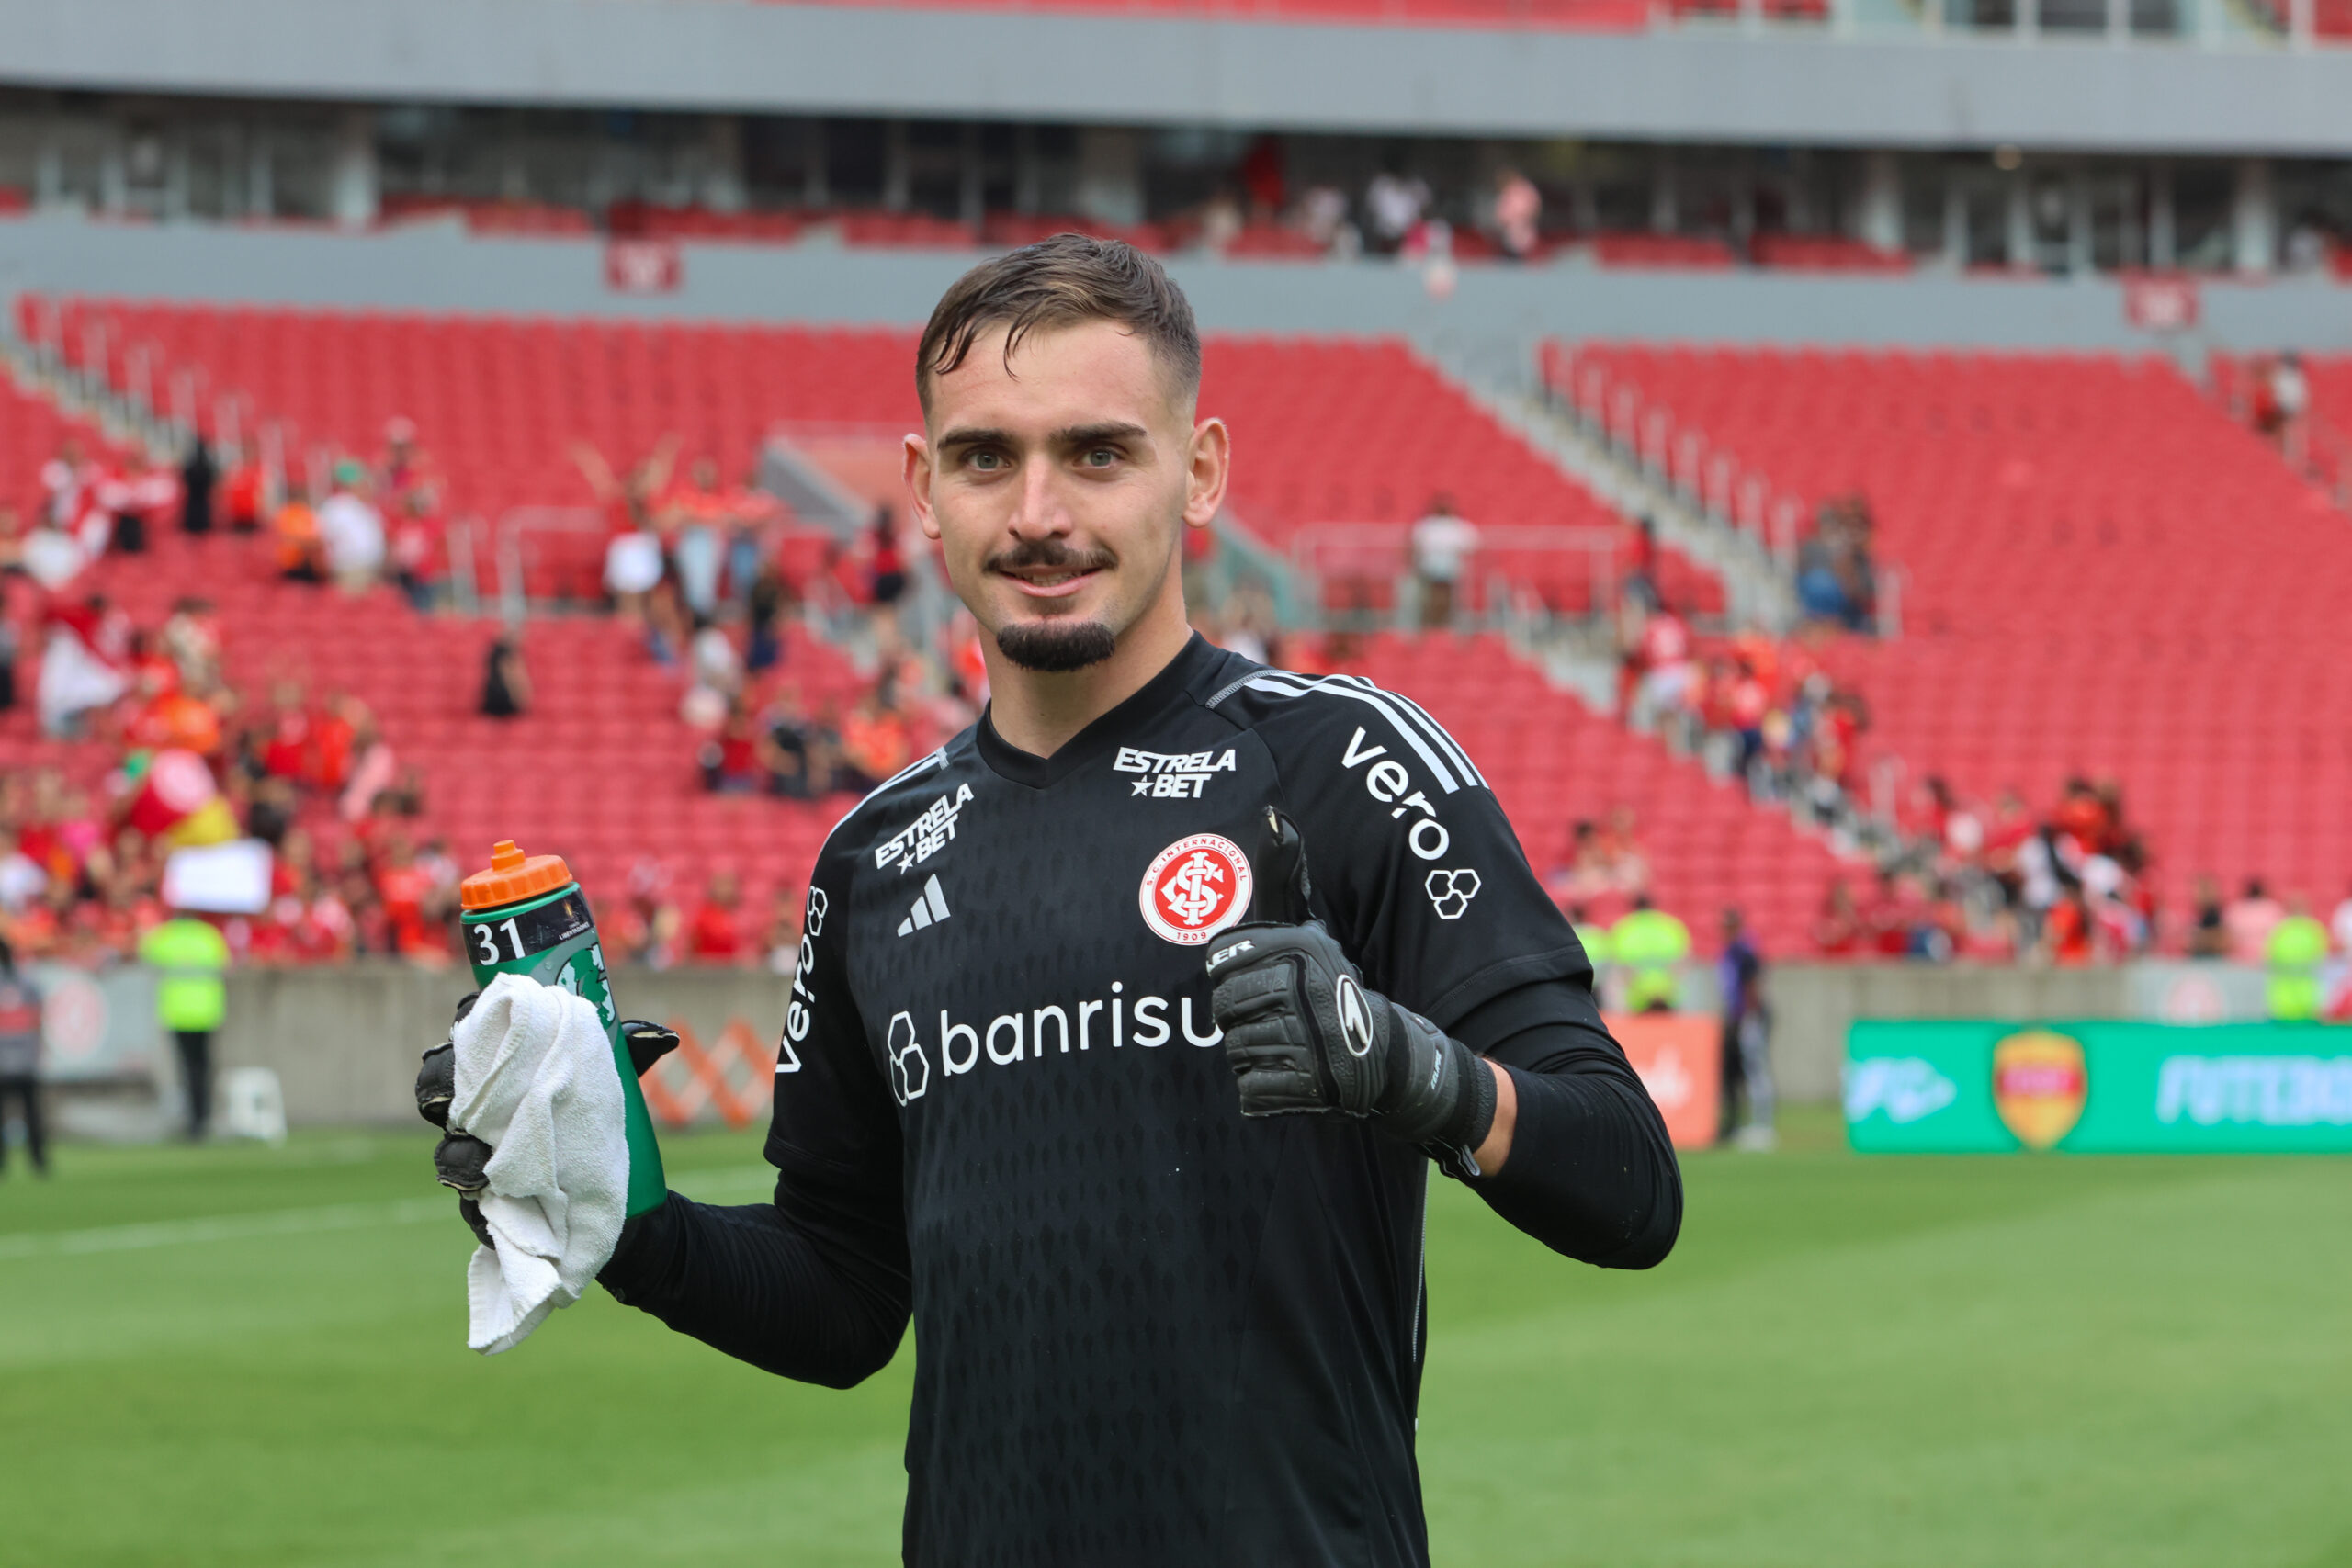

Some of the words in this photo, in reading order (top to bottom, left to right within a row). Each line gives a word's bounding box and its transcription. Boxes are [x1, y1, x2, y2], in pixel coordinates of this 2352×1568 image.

[1113, 746, 1237, 773] ESTRELA
[1151, 773, 1212, 798] BET
[1341, 725, 1450, 861] vero
[875, 783, 975, 870] ESTRELA
[916, 813, 958, 863] BET
[474, 917, 526, 966] 31
[1177, 931, 1207, 942] 1909
[775, 933, 815, 1073] vero
[940, 981, 1225, 1077] banrisu
